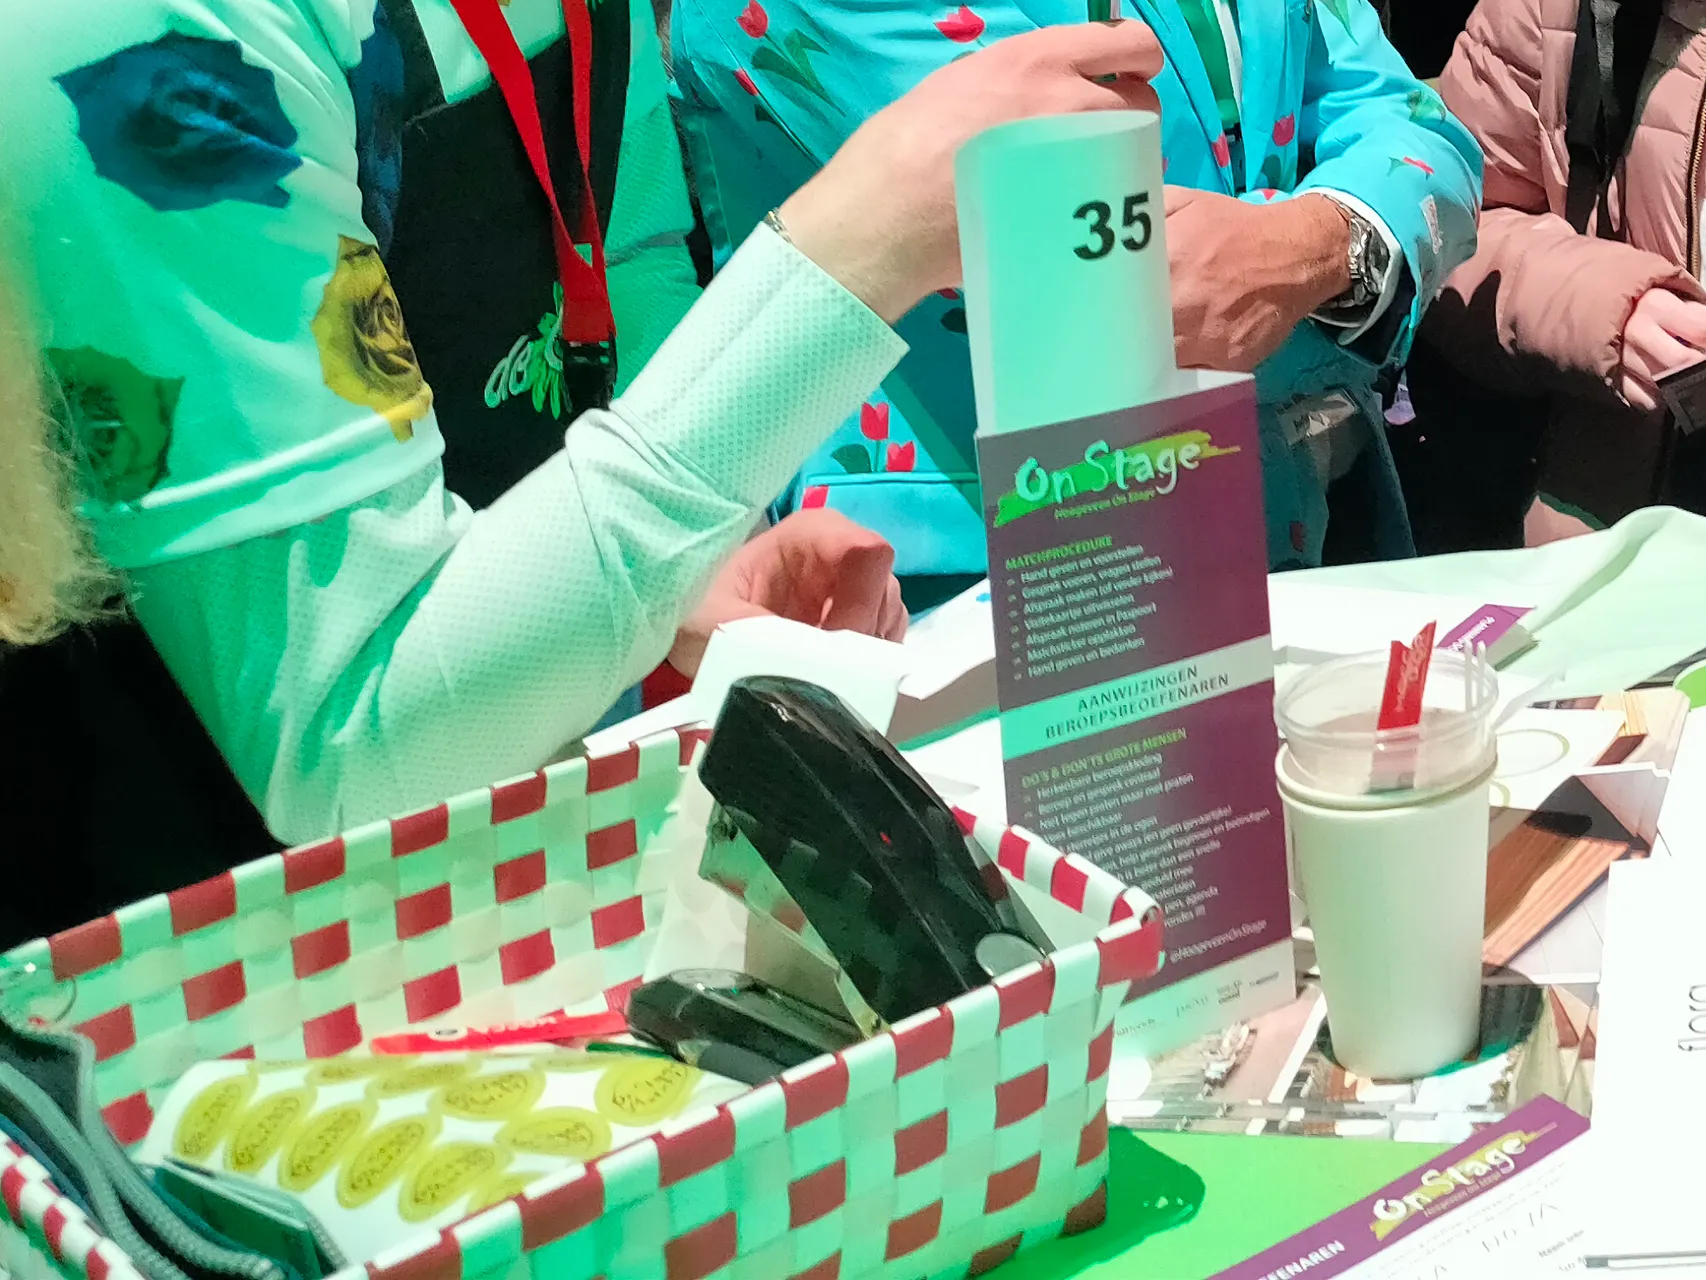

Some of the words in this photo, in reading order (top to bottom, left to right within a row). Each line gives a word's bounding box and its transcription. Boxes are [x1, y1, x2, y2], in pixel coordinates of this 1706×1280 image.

[1072, 191, 1152, 261] 35
[1015, 456, 1077, 503] On
[1085, 440, 1200, 495] Stage
[1046, 675, 1230, 739] BEROEPSBEOEFENAREN
[1078, 666, 1199, 712] AANWIJZINGEN
[1373, 1191, 1432, 1221] On
[1421, 1137, 1527, 1195] Stage
